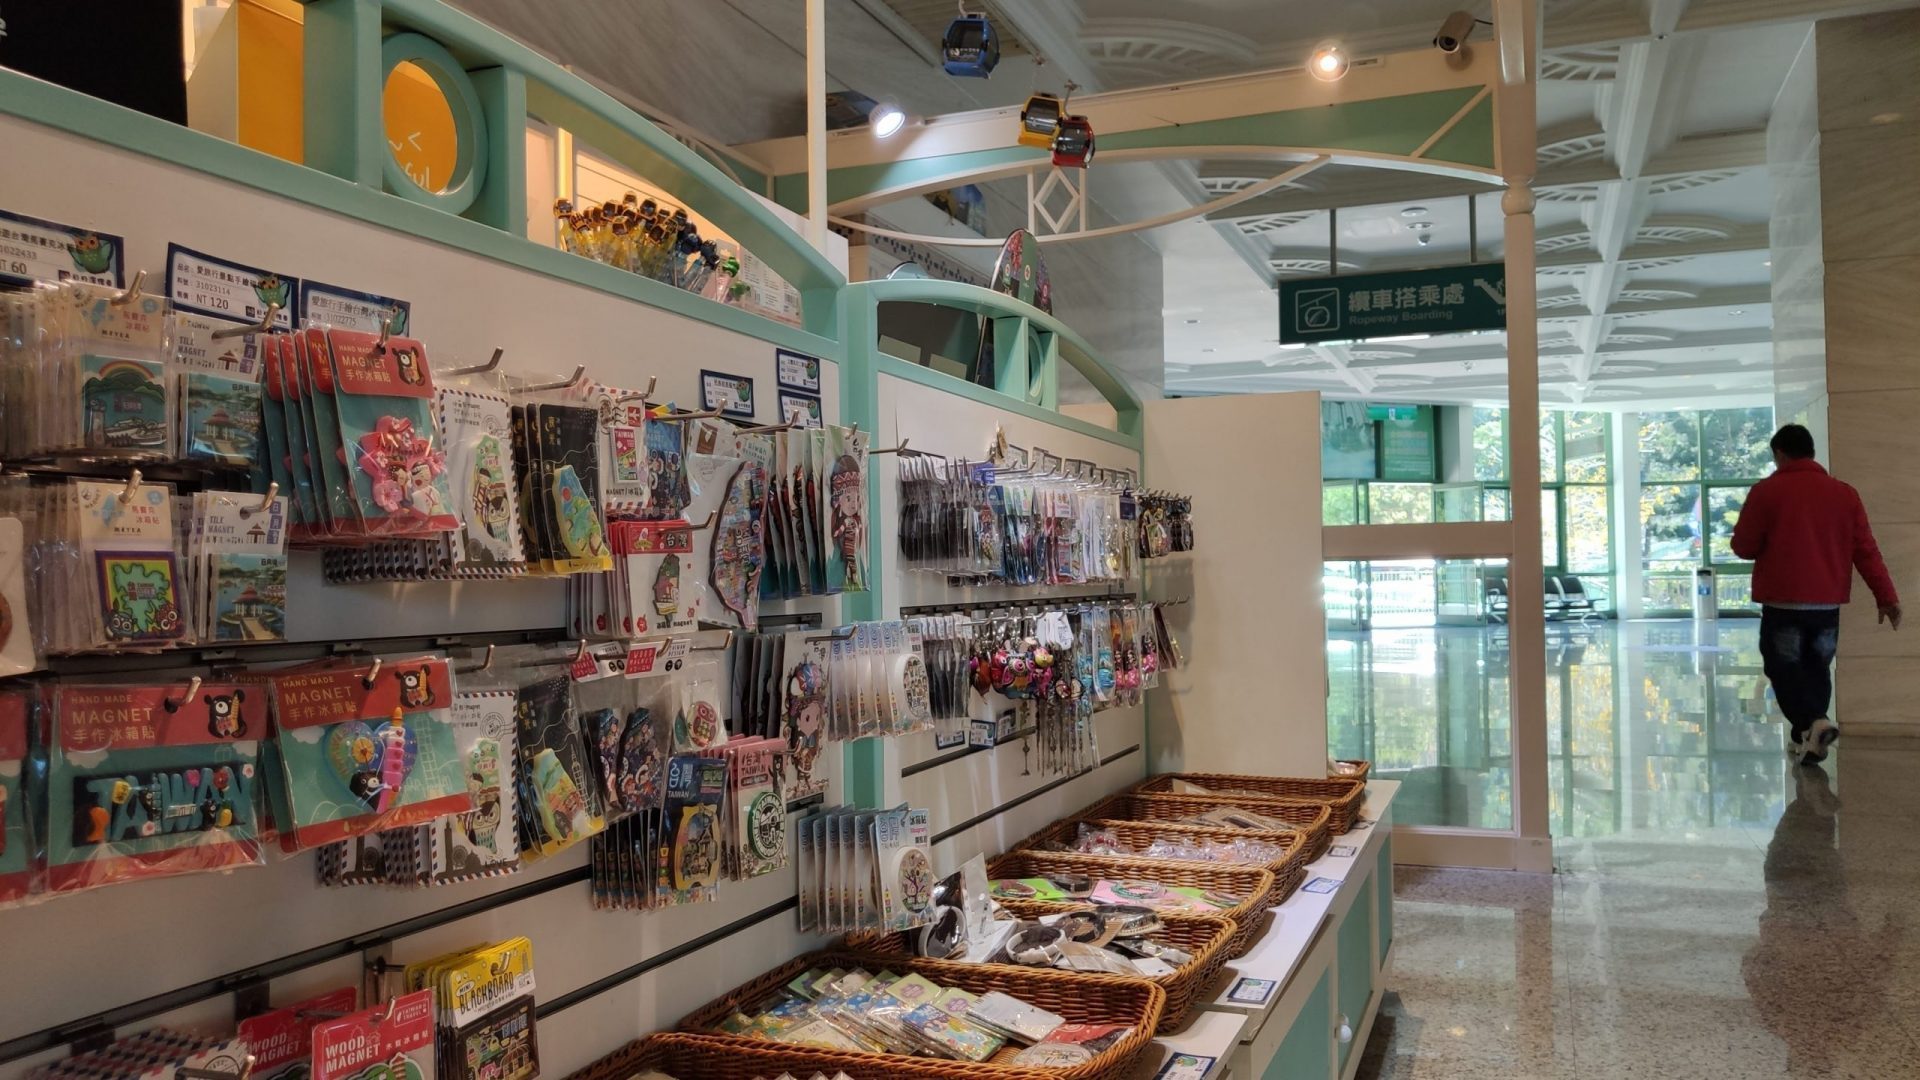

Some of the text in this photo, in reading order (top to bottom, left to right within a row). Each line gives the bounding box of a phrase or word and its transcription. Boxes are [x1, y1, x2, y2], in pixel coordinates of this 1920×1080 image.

[11, 262, 27, 274] 60
[196, 280, 231, 296] 31023114
[196, 294, 207, 305] NT
[211, 296, 229, 310] 120
[1348, 283, 1465, 312] 纜車搭乘處
[1349, 308, 1454, 326] Ropeway Boarding
[342, 355, 386, 369] MAGNET
[666, 533, 688, 548] 台灣
[282, 676, 335, 689] HAND MADE
[72, 694, 132, 705] HAND MADE
[284, 686, 353, 705] MAGNET
[72, 707, 153, 725] MAGNET
[288, 700, 358, 721] 手作冰箱貼
[72, 725, 155, 744] 手作冰箱貼
[741, 764, 766, 776] TAIWAN
[668, 790, 690, 799] TAIWAN
[458, 971, 515, 1015] BLACKBOARD
[252, 1032, 288, 1053] WOOD
[325, 1035, 366, 1060] WOOD
[326, 1043, 381, 1074] MAGNET
